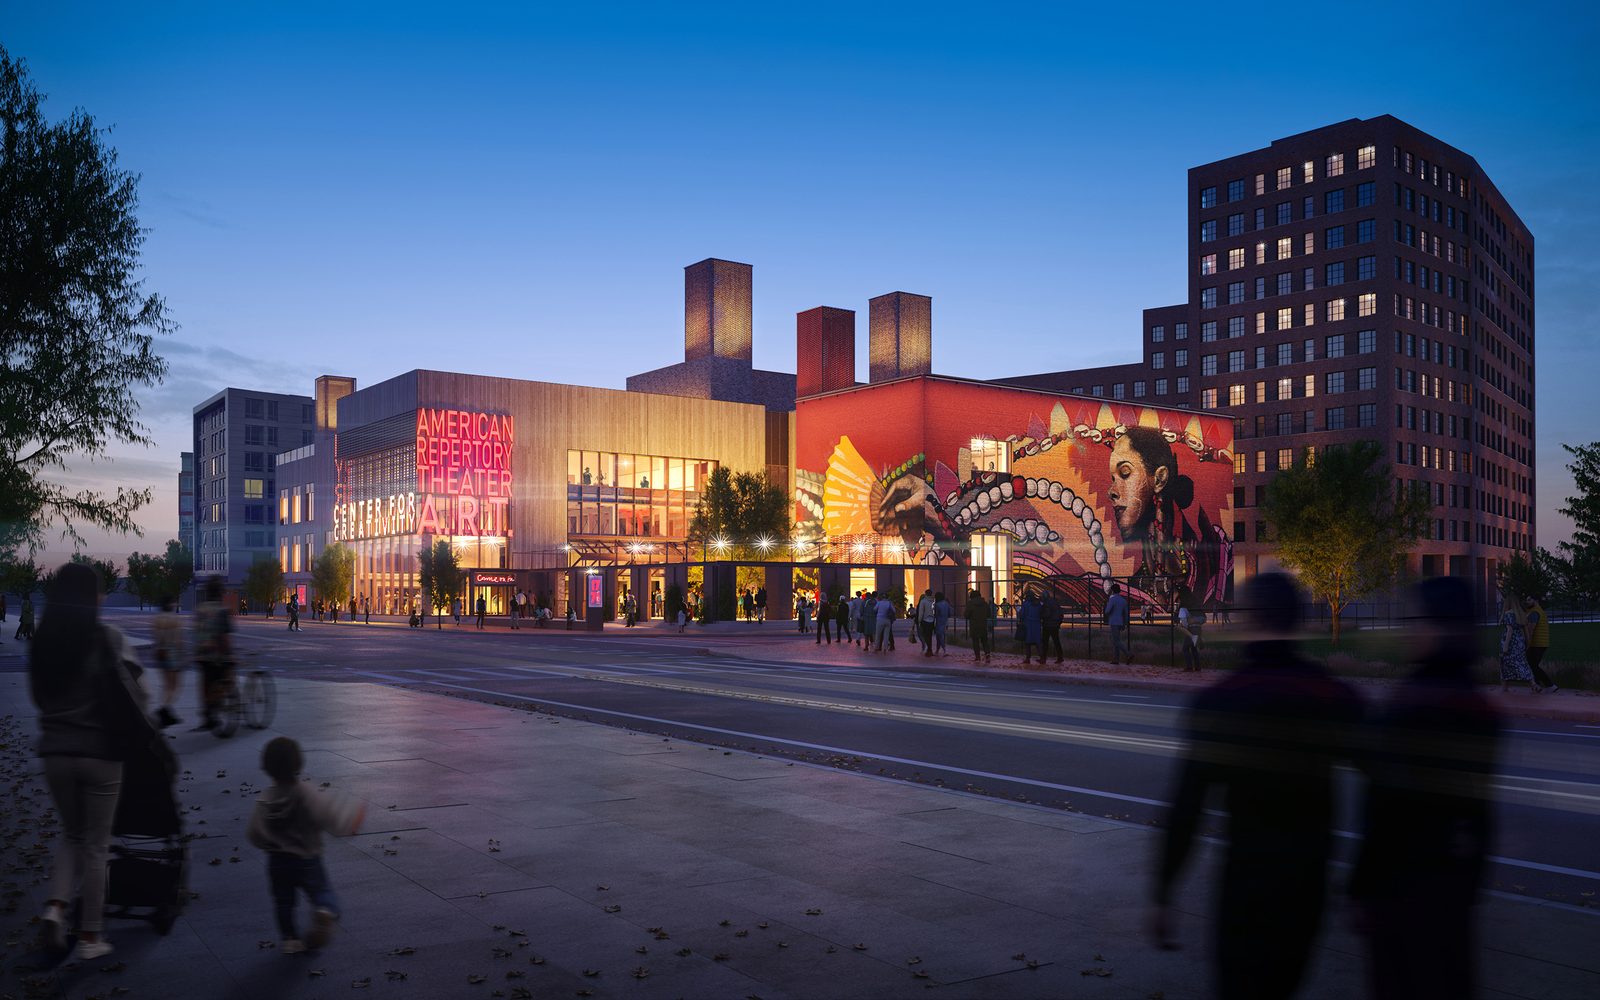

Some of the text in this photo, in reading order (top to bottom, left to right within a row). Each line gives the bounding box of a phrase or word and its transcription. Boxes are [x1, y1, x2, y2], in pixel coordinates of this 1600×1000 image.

[416, 407, 514, 442] AMERICAN
[416, 437, 513, 469] REPERTORY
[416, 465, 513, 497] THEATER
[333, 492, 415, 524] CENTER FOR
[416, 493, 514, 537] A.R.T.
[333, 513, 415, 541] CREATIVITY
